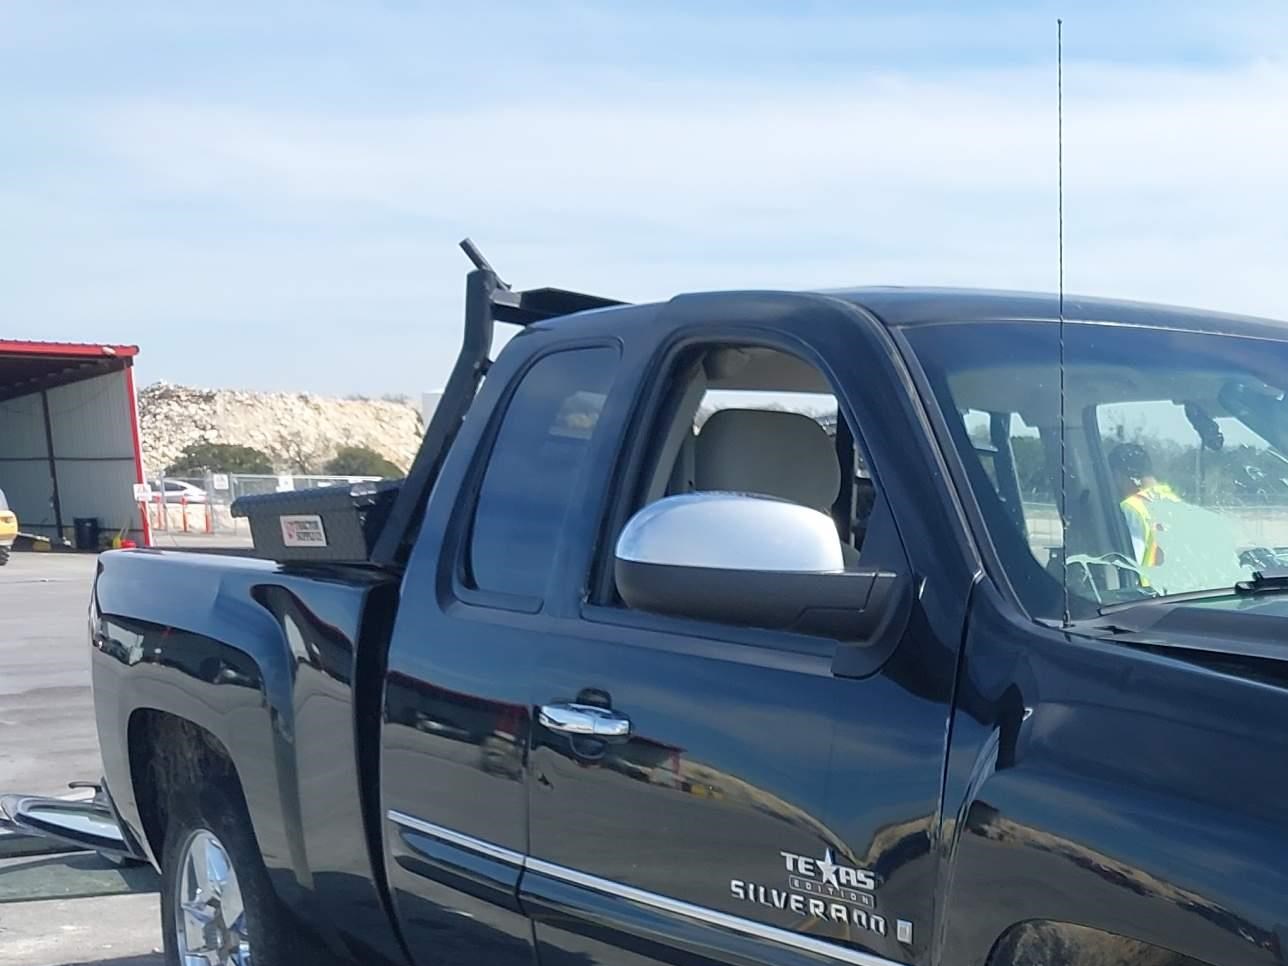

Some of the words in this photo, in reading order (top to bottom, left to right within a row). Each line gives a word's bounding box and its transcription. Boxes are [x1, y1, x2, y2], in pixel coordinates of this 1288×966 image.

[780, 848, 875, 890] TEXAS
[730, 879, 887, 936] SILVERADO
[793, 878, 870, 906] EDITION
